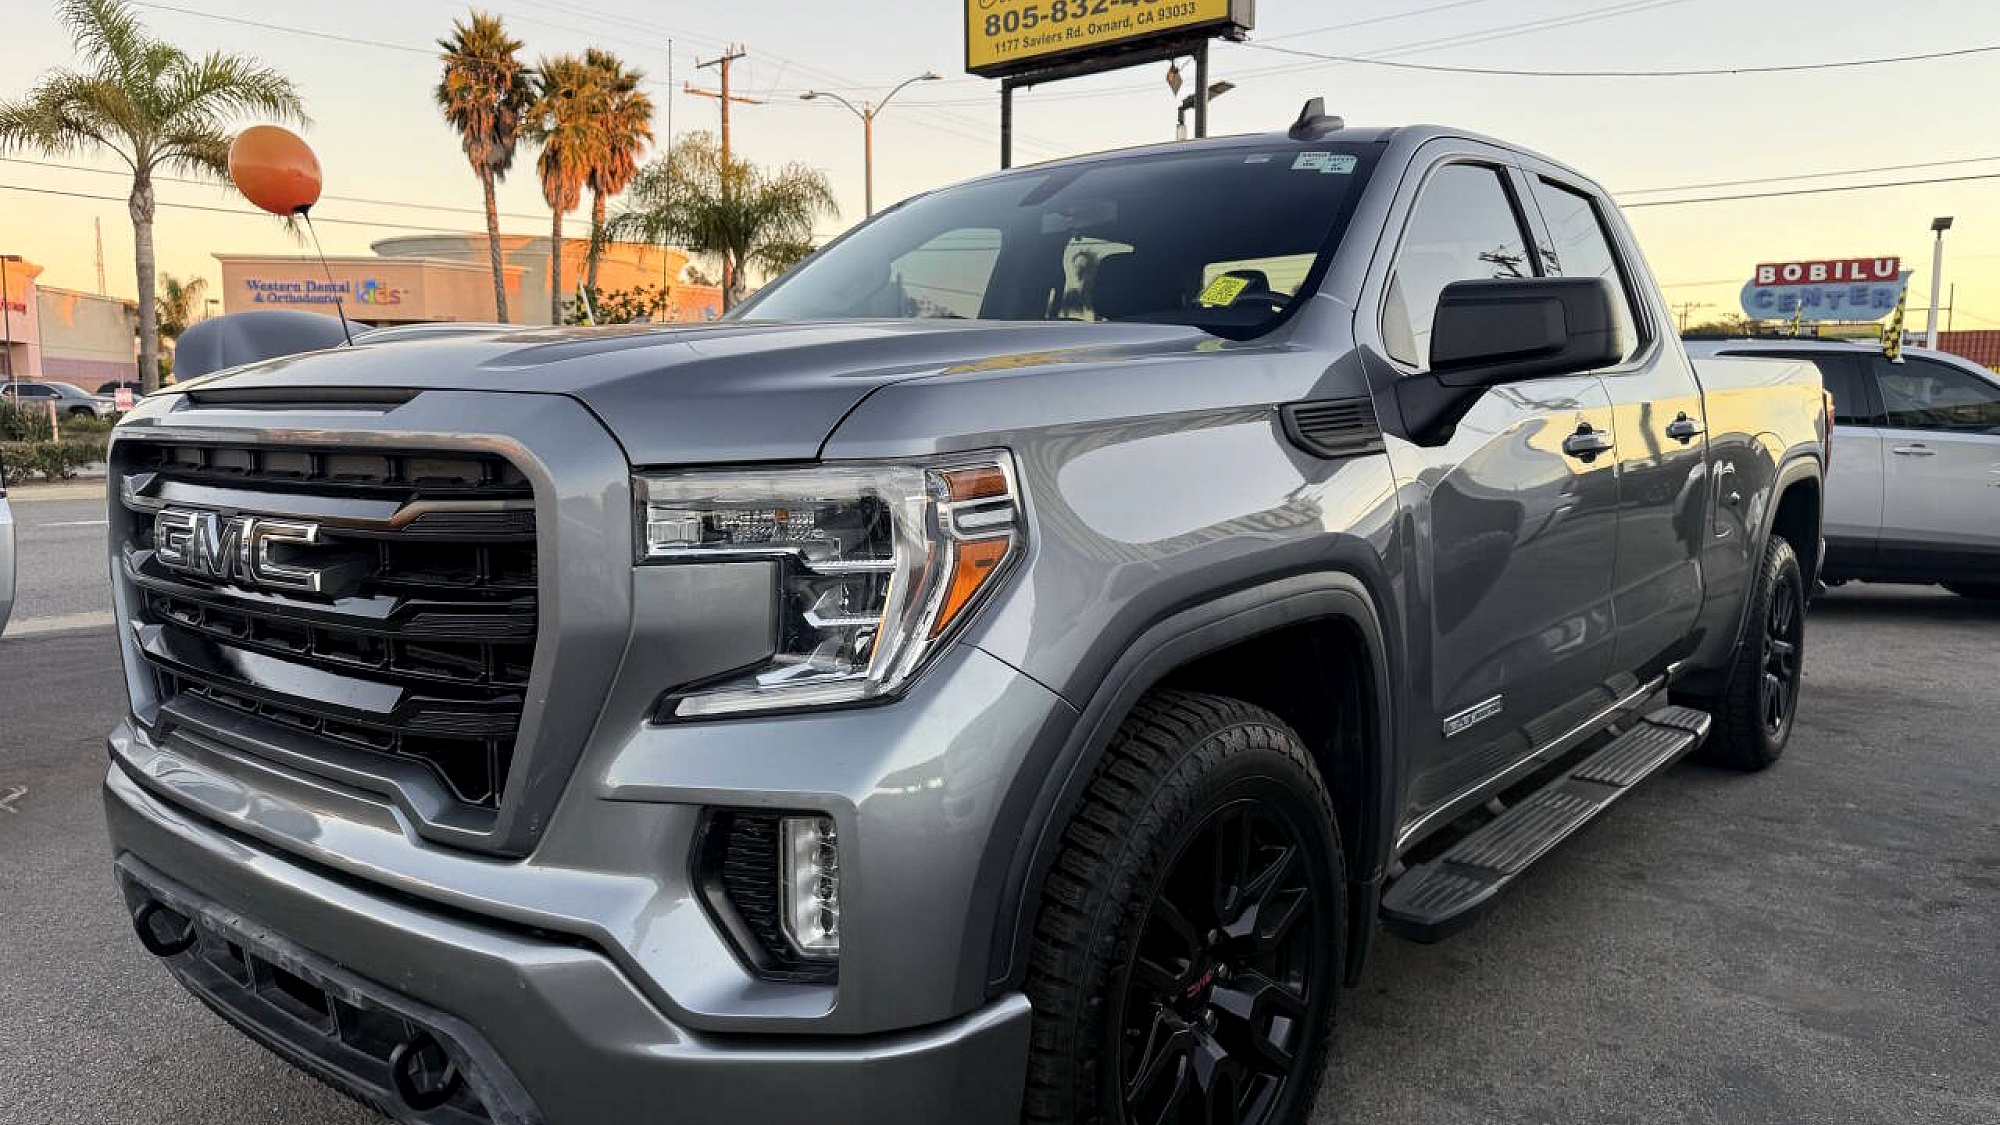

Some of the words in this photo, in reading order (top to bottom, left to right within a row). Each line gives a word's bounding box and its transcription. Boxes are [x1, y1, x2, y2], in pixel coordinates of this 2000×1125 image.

[985, 0, 1157, 37] 805-832-
[995, 38, 1019, 56] 1177
[1022, 32, 1062, 48] Saviers
[1066, 25, 1083, 40] Rd.
[1088, 18, 1133, 35] Oxnard,
[1137, 11, 1154, 25] CA
[1158, 2, 1195, 20] 93033
[1758, 259, 1893, 284] BOBILU
[247, 279, 300, 292] Western
[305, 280, 350, 293] Dental
[254, 292, 264, 302] &
[1754, 285, 1893, 313] CENTER
[154, 508, 322, 592] GMC
